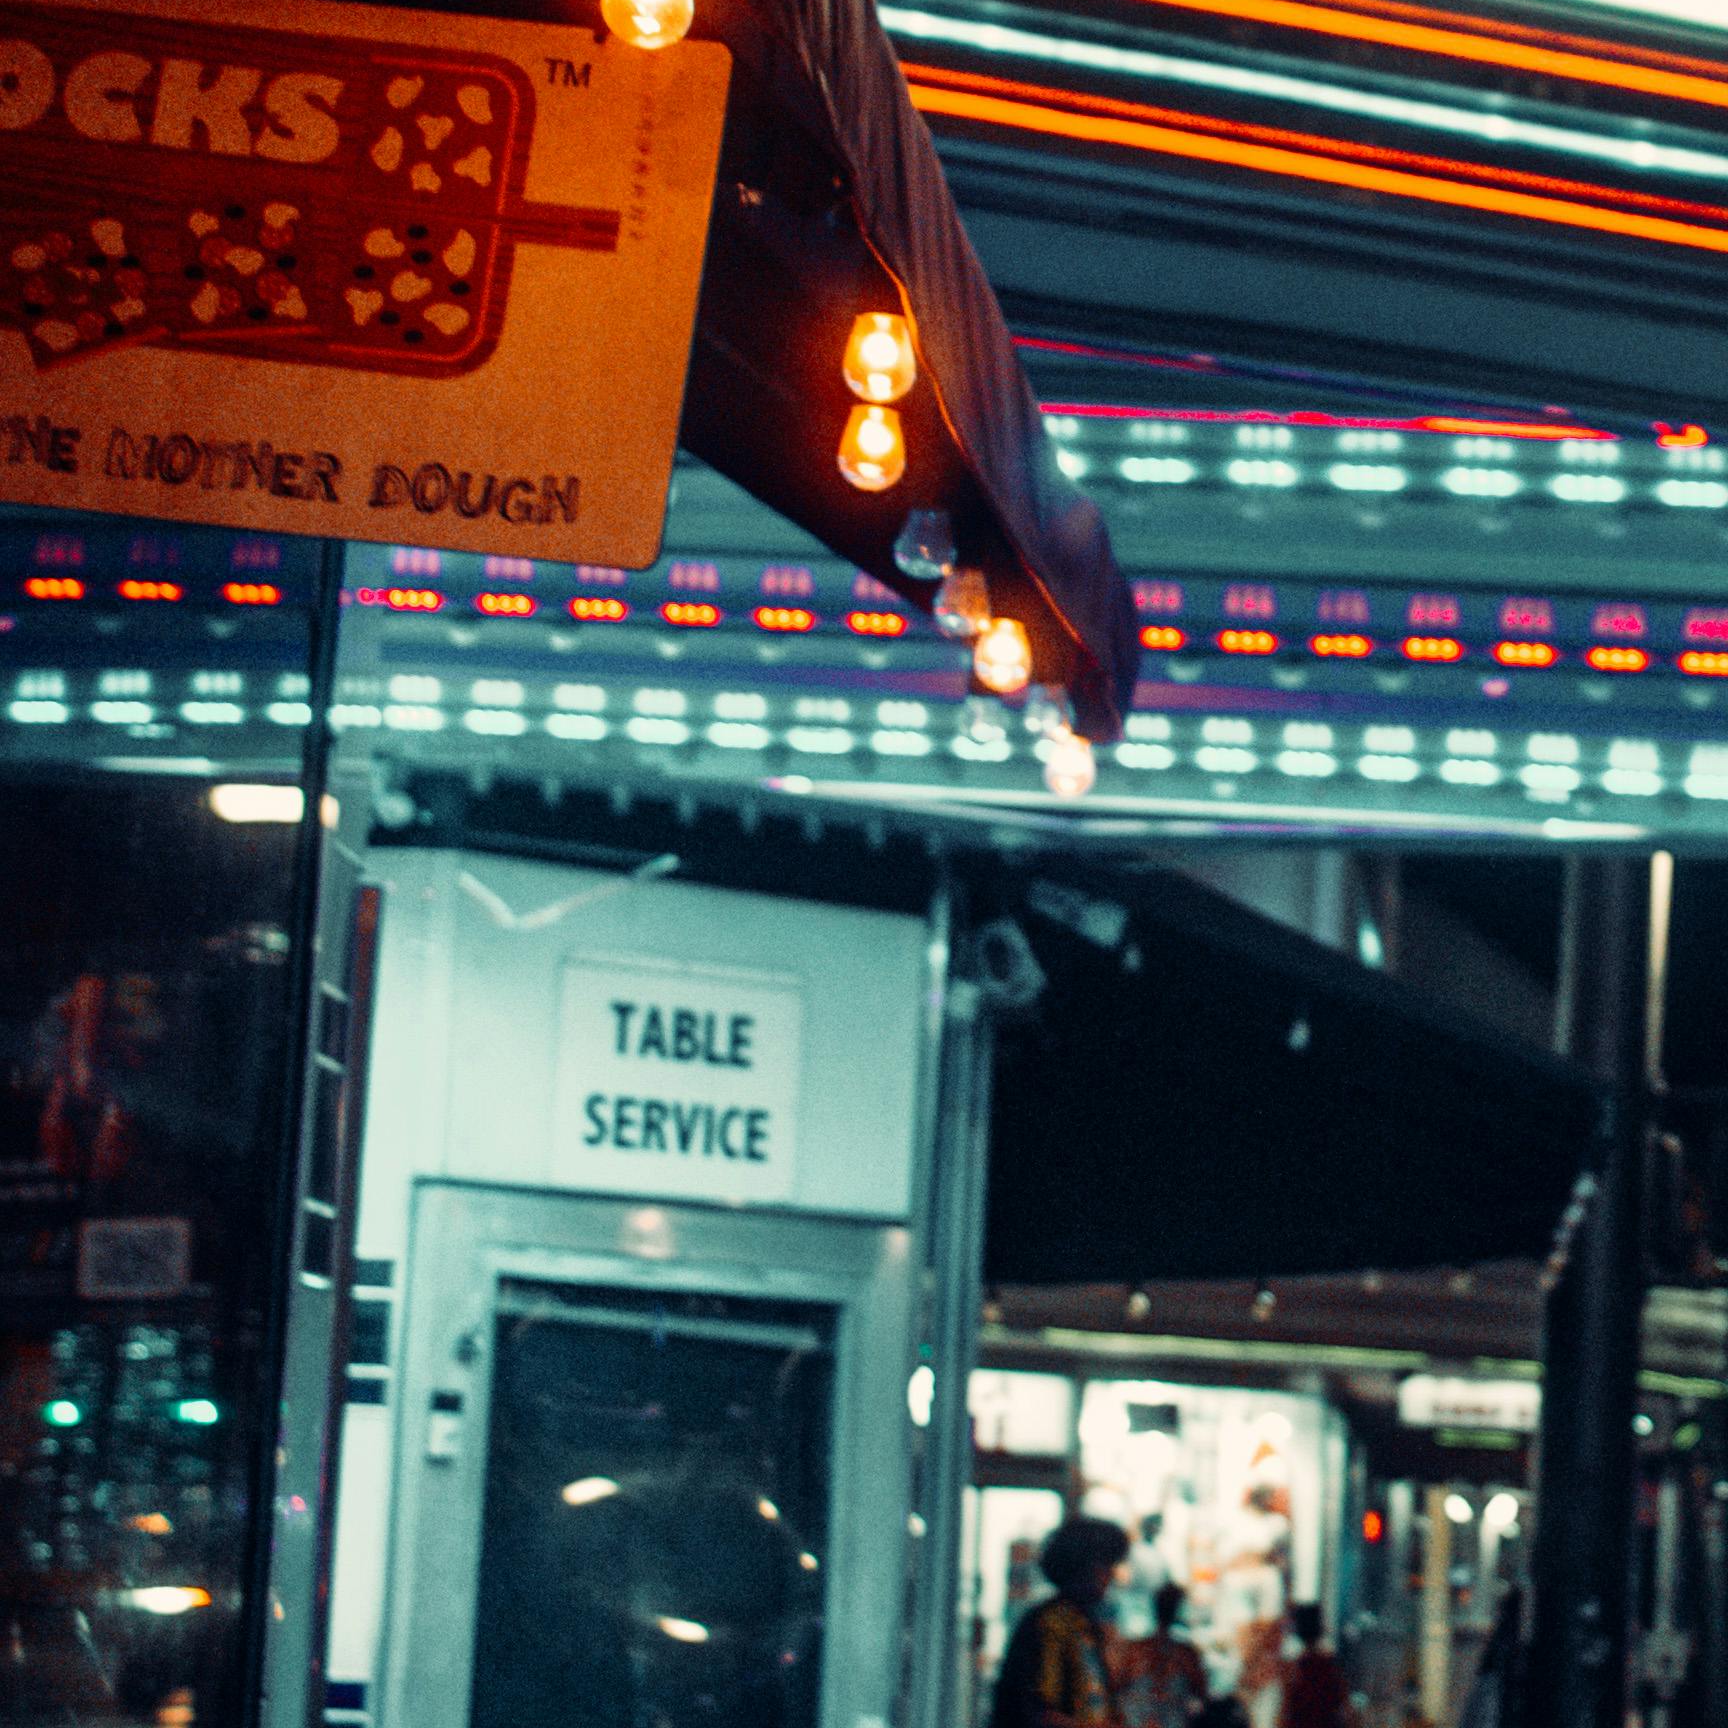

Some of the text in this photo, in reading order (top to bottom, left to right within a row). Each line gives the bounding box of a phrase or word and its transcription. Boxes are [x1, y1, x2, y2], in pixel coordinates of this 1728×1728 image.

[544, 56, 593, 89] TM
[0, 413, 82, 474] HE
[368, 461, 581, 524] DOUGH
[611, 999, 756, 1070] TABLE
[583, 1092, 769, 1163] SERVICE
